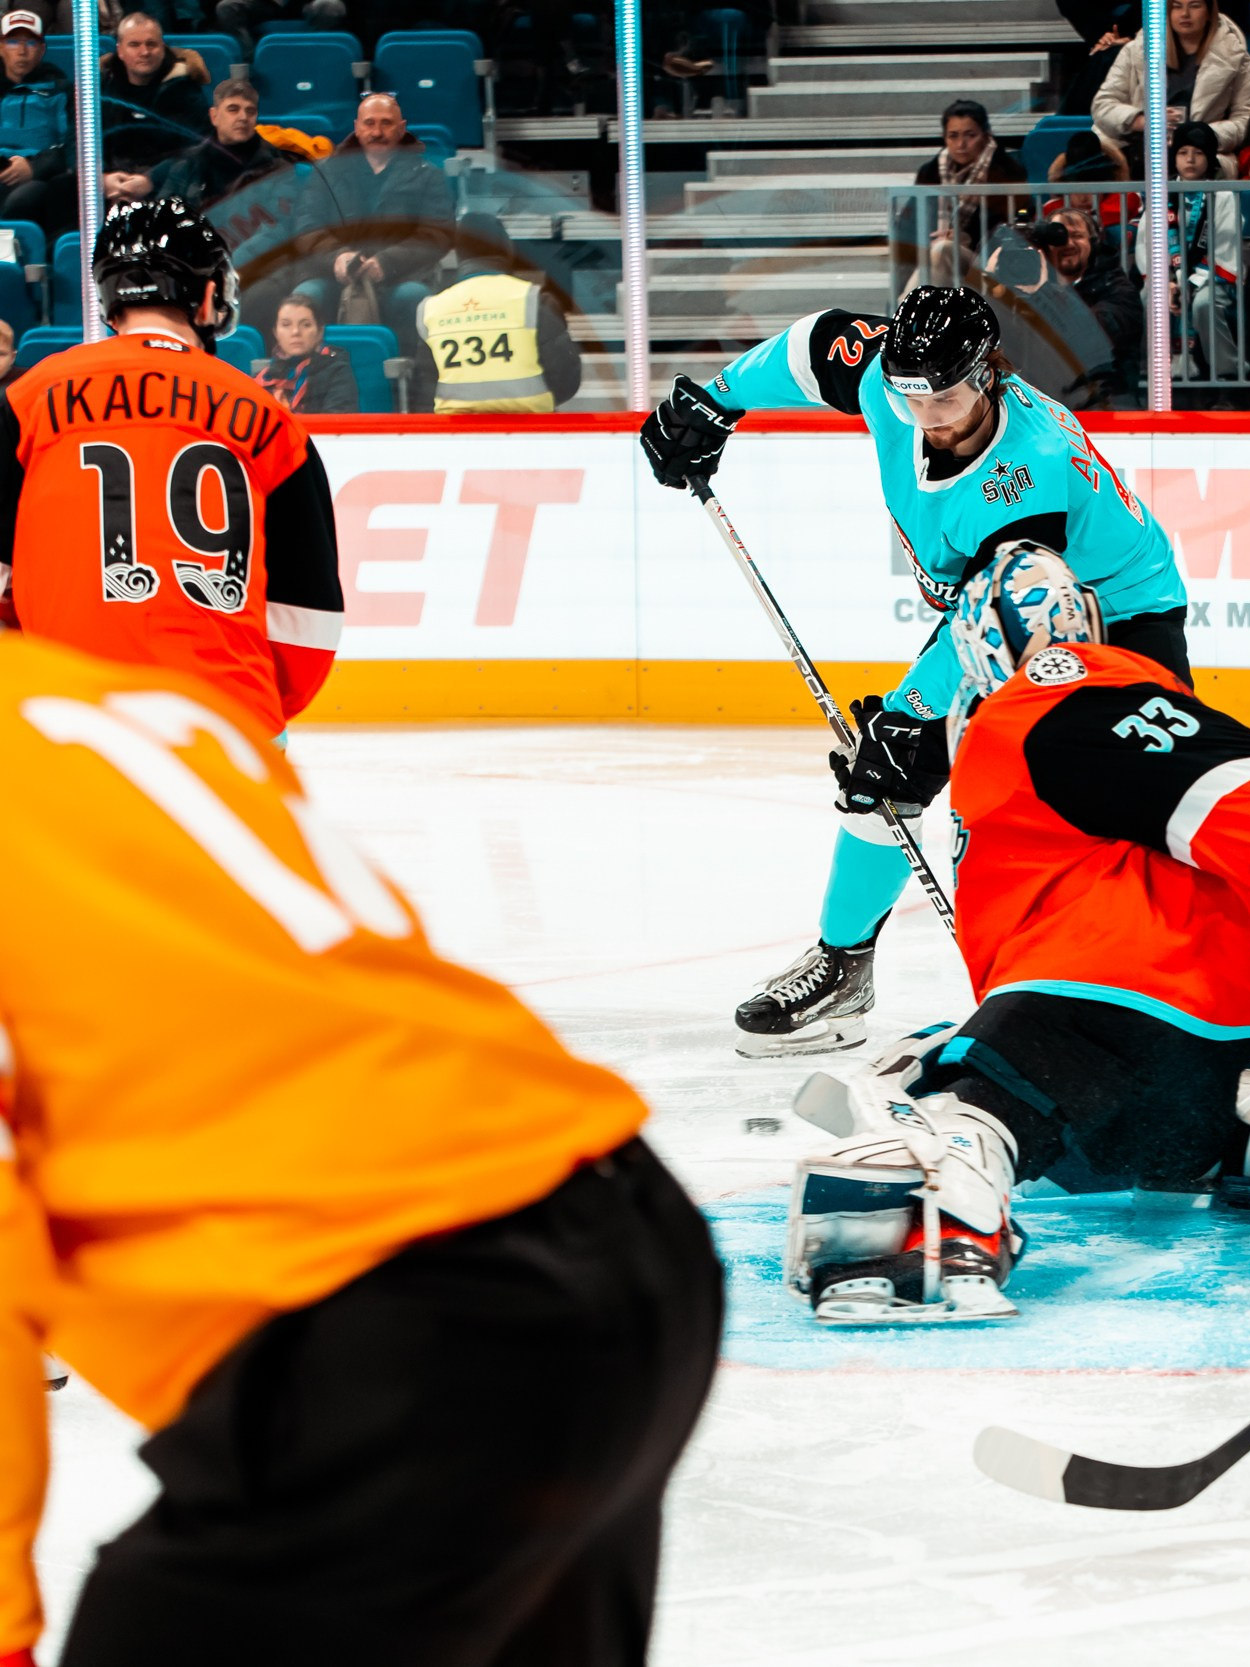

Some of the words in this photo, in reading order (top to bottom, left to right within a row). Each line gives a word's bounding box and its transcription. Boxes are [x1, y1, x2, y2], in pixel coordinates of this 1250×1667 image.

[440, 332, 514, 369] 234
[893, 381, 929, 390] согаз
[47, 371, 282, 459] TKACHYOV
[980, 465, 1035, 507] SKA
[79, 441, 254, 614] 19
[1111, 696, 1201, 753] 33
